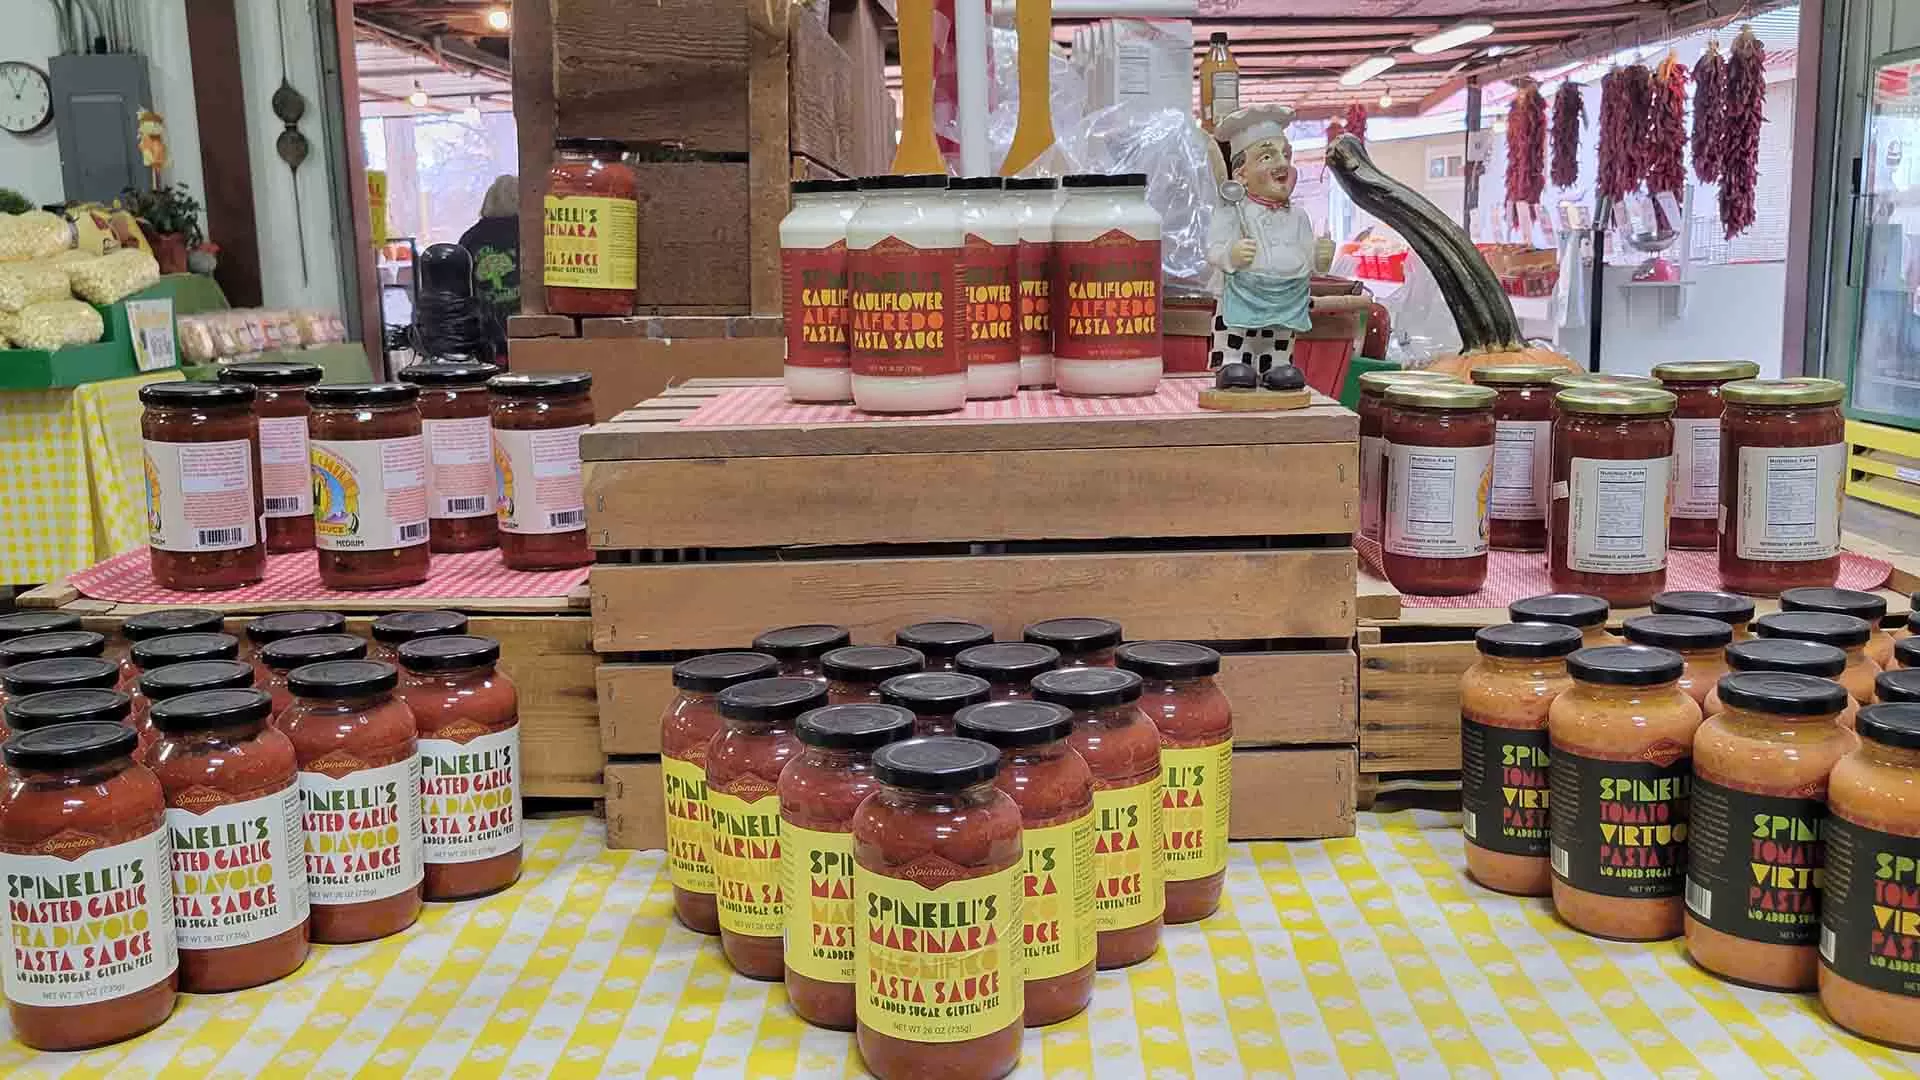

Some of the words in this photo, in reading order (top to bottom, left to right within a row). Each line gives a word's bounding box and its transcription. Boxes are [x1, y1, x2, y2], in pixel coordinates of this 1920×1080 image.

[853, 291, 943, 311] CAULIFLOWER
[1069, 280, 1155, 299] CAULIFLOWER
[1070, 299, 1156, 317] ALFREDO
[854, 312, 945, 331] ALFREDO
[971, 322, 1012, 340] SAUCE
[1069, 318, 1110, 335] PASTA
[1116, 316, 1156, 335] SAUCE
[803, 326, 846, 343] PASTA
[854, 332, 889, 349] PASTA
[894, 331, 944, 350] SAUCE
[473, 767, 512, 792] GARLIC
[446, 786, 512, 814] DIAVOLO
[1161, 788, 1204, 808] ARA
[349, 804, 398, 830] GARLIC
[468, 806, 513, 833] SAUCE
[1600, 801, 1669, 823] TOMATO
[319, 825, 399, 853] DIAVOLO
[448, 835, 472, 845] SUGAR
[671, 837, 706, 862] PASTA
[713, 834, 782, 859] MARINA
[1095, 830, 1140, 854] ARA
[214, 840, 272, 870] GARLIC
[344, 846, 400, 873] SAUCE
[1600, 845, 1660, 867] PASTA
[8, 859, 145, 899] SPINELLI'S
[183, 863, 272, 895] DIAVOLO
[322, 876, 349, 885] SUGAR
[1615, 867, 1644, 879] ADDED
[211, 884, 277, 917] SAUCE
[718, 875, 755, 903] PASTA
[10, 899, 83, 923] ROASTED
[88, 884, 147, 918] GARLIC
[744, 904, 768, 915] SUGAR
[868, 892, 998, 928] SPINELLI'S
[12, 924, 47, 949] FRA
[53, 909, 149, 949] DIAVOLO
[189, 917, 219, 928] SUGAR
[223, 911, 259, 926] GLUTEN
[1766, 912, 1796, 924] ADDED
[868, 918, 999, 953] MARINARA
[16, 948, 74, 972] PASTA
[84, 931, 152, 969] SAUCE
[1041, 943, 1060, 956] FREE
[29, 973, 55, 984] ADDED
[58, 971, 91, 984] SUGAR
[97, 962, 134, 979] GLUTEN
[135, 954, 152, 970] FREE
[870, 969, 926, 1004] PASTA
[935, 970, 1000, 1004] SAUCE
[881, 1001, 906, 1015] ADDED
[908, 1004, 940, 1018] SUGAR
[946, 1001, 981, 1018] GLUTEN
[982, 995, 1000, 1010] FREE
[893, 1023, 907, 1032] NET
[908, 1024, 921, 1033] WT
